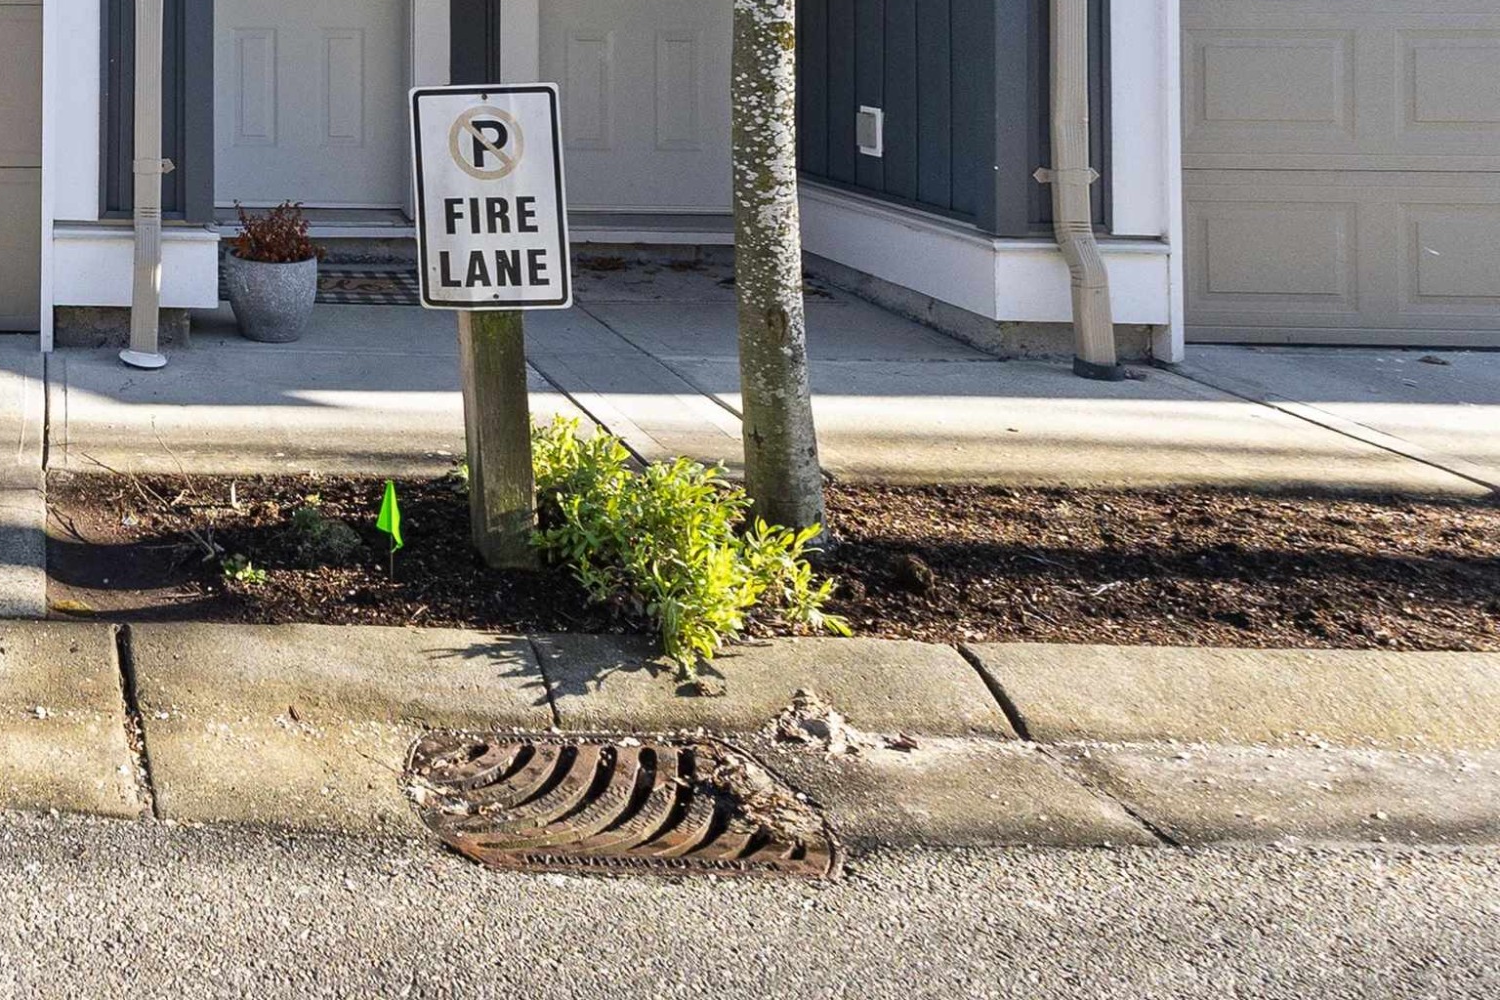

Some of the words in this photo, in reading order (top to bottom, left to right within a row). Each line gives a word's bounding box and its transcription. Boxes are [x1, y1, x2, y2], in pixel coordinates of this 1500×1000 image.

[471, 120, 508, 168] P
[444, 196, 538, 235] FIRE
[439, 249, 550, 288] LANE
